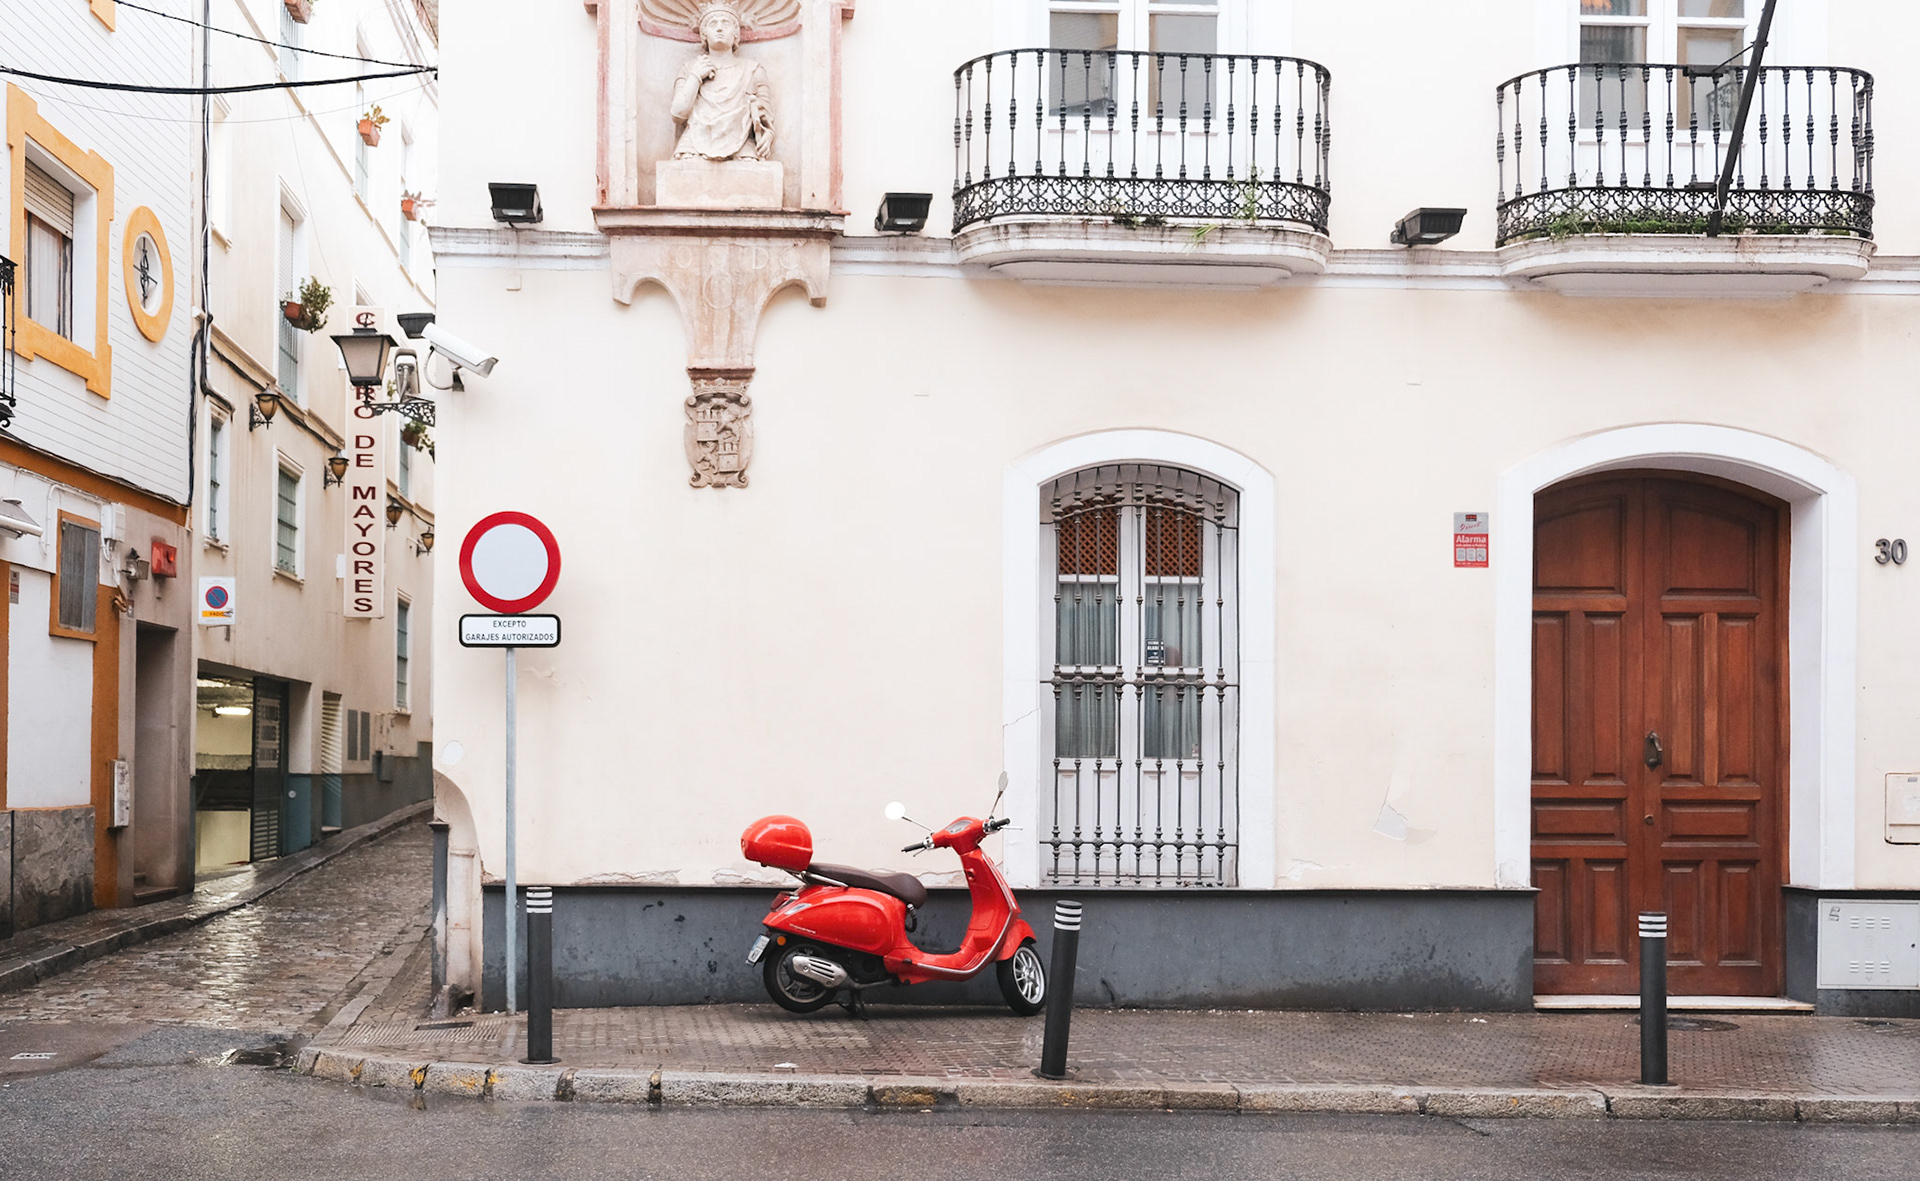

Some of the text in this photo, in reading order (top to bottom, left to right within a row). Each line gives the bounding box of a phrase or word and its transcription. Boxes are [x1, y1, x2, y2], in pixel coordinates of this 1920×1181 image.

[352, 312, 376, 612] CRO DE MAYORES
[1456, 535, 1487, 543] Alarma
[1875, 538, 1908, 565] 30
[493, 620, 526, 628] EXCEPTO
[465, 633, 554, 641] GARAJES AUTORIZADOS
